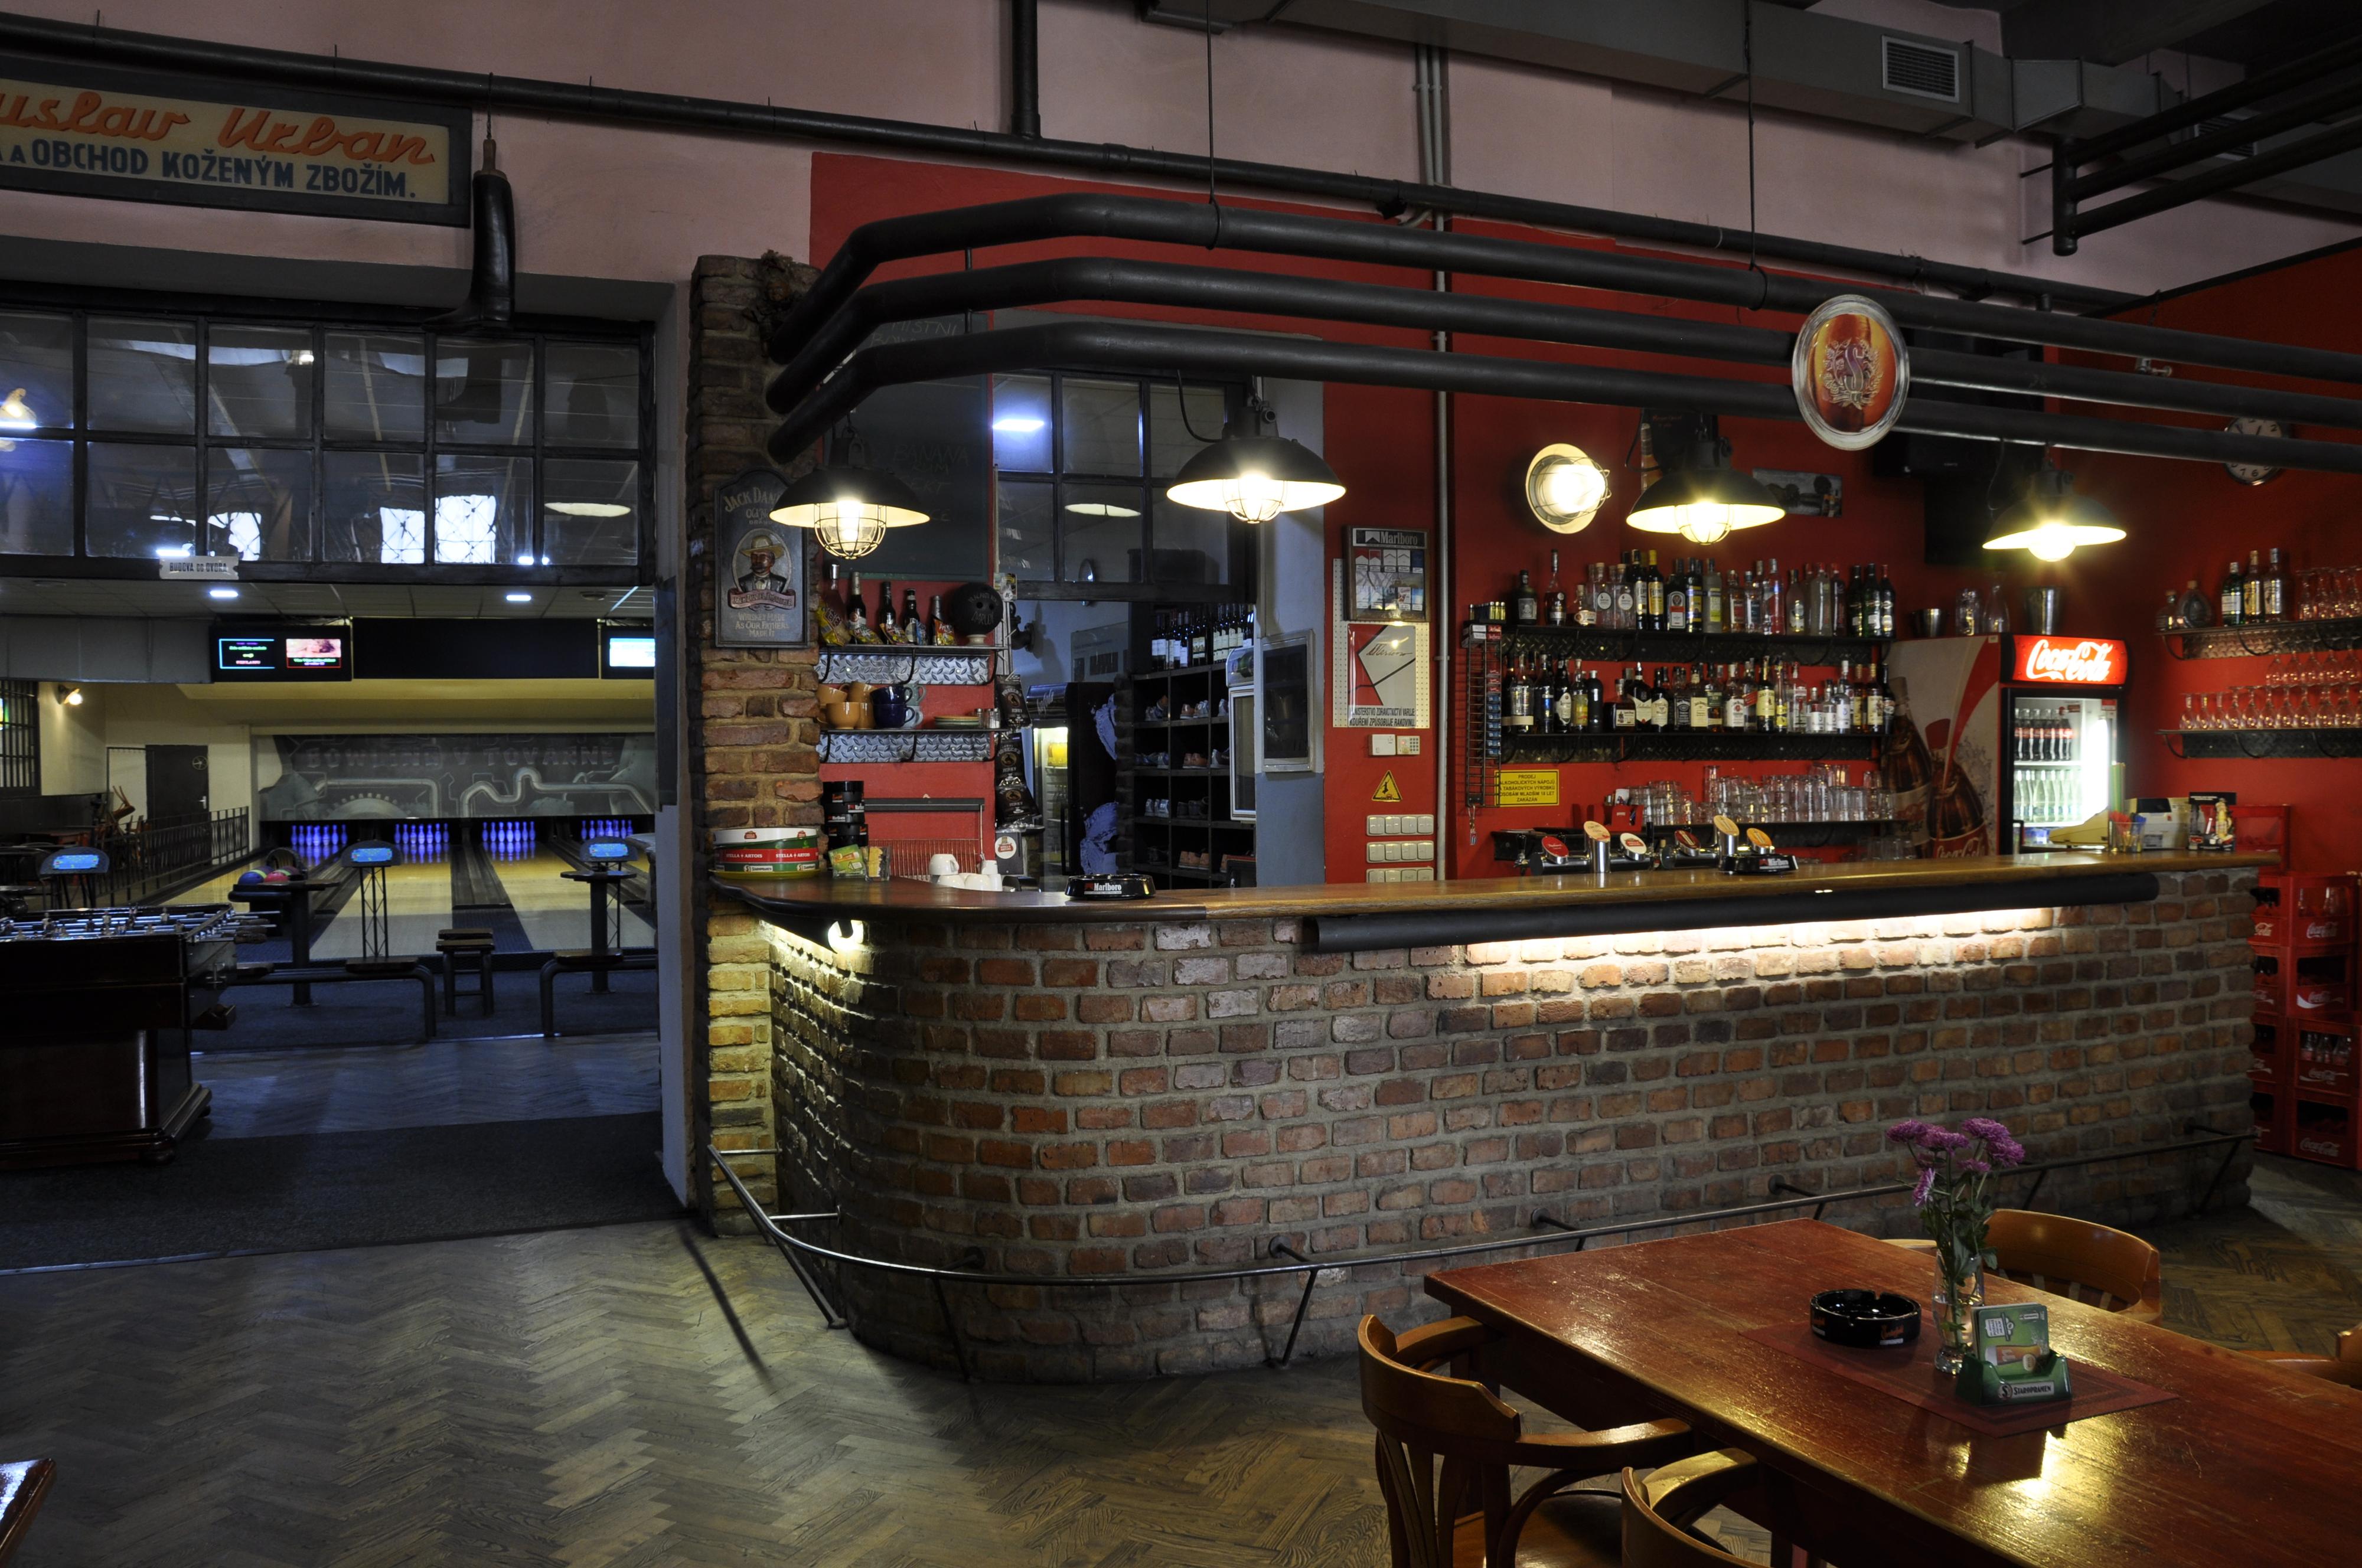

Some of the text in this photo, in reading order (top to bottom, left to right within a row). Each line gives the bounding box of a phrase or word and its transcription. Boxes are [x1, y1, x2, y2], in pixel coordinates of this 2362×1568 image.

[217, 107, 435, 166] Urban
[10, 139, 417, 198] A OBCHOD KOŽENÝM ZBOŽÍM.
[723, 491, 752, 512] JACK
[1381, 531, 1418, 545] Marlboro
[169, 562, 194, 572] BUDOVA
[2026, 639, 2114, 682] Coca-Cola
[1349, 717, 1369, 727] KOUŘENÍ
[1369, 716, 1394, 727] ZPŮSOBUJE
[1094, 883, 1122, 891] Marlboro
[2014, 1386, 2051, 1395] STAROPRAMEN
